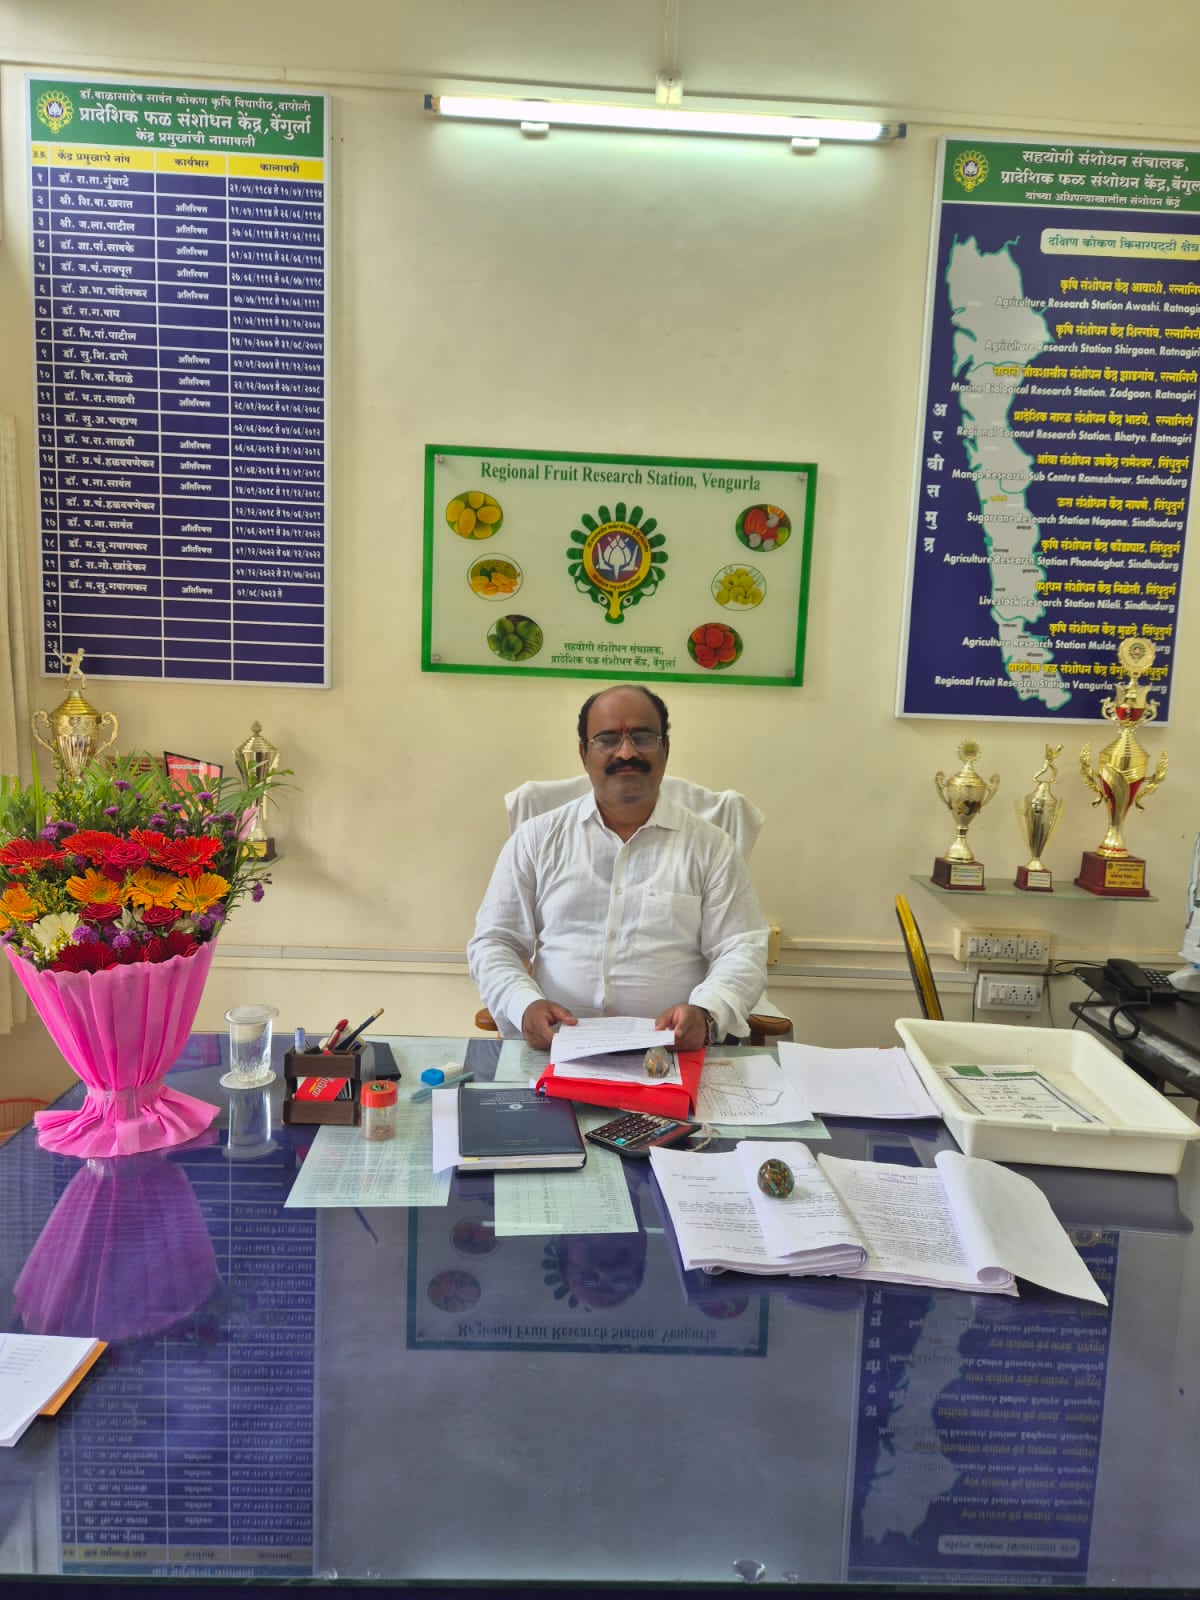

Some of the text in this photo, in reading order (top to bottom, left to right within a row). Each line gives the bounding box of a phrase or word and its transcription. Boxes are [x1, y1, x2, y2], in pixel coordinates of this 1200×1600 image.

[80, 103, 138, 124] प्रादेशिक
[144, 110, 171, 126] फळ
[177, 109, 231, 129] संशोधन
[136, 131, 154, 143] केंद्र
[1023, 148, 1188, 171] सहयोगी संशोधन संचालक,
[1002, 168, 1054, 185] प्रादेशिक
[1059, 175, 1085, 186] फळ
[1091, 171, 1140, 188] संशोधन
[1130, 194, 1162, 206] संशोधन
[1081, 279, 1112, 292] संशोधन
[1049, 298, 1089, 310] Research
[1091, 300, 1123, 310] Station
[1076, 325, 1108, 337] संशोधन
[1081, 343, 1112, 354] Station
[1031, 384, 1072, 396] Research
[1156, 388, 1196, 402] Ratnagiri
[1037, 430, 1076, 440] Research
[1151, 432, 1192, 445] Ratnagiri
[480, 462, 760, 493] Regional Fruit Research Station, Vengurla
[952, 469, 983, 479] Mango
[1029, 472, 1045, 481] Sub
[1047, 472, 1076, 482] Centre
[1136, 474, 1187, 487] Sindhudurg
[1059, 515, 1090, 525] Station
[1132, 517, 1183, 530] Sindhudurg
[944, 553, 992, 566] Agriculture
[1038, 556, 1068, 567] Station
[1128, 558, 1179, 572] Sindhudurg
[1065, 598, 1095, 609] Station
[1125, 600, 1175, 613] Sindhudurg
[598, 642, 627, 655] संशोधन
[1055, 640, 1086, 650] Station
[935, 676, 973, 688] Regional
[976, 675, 996, 686] Fruit
